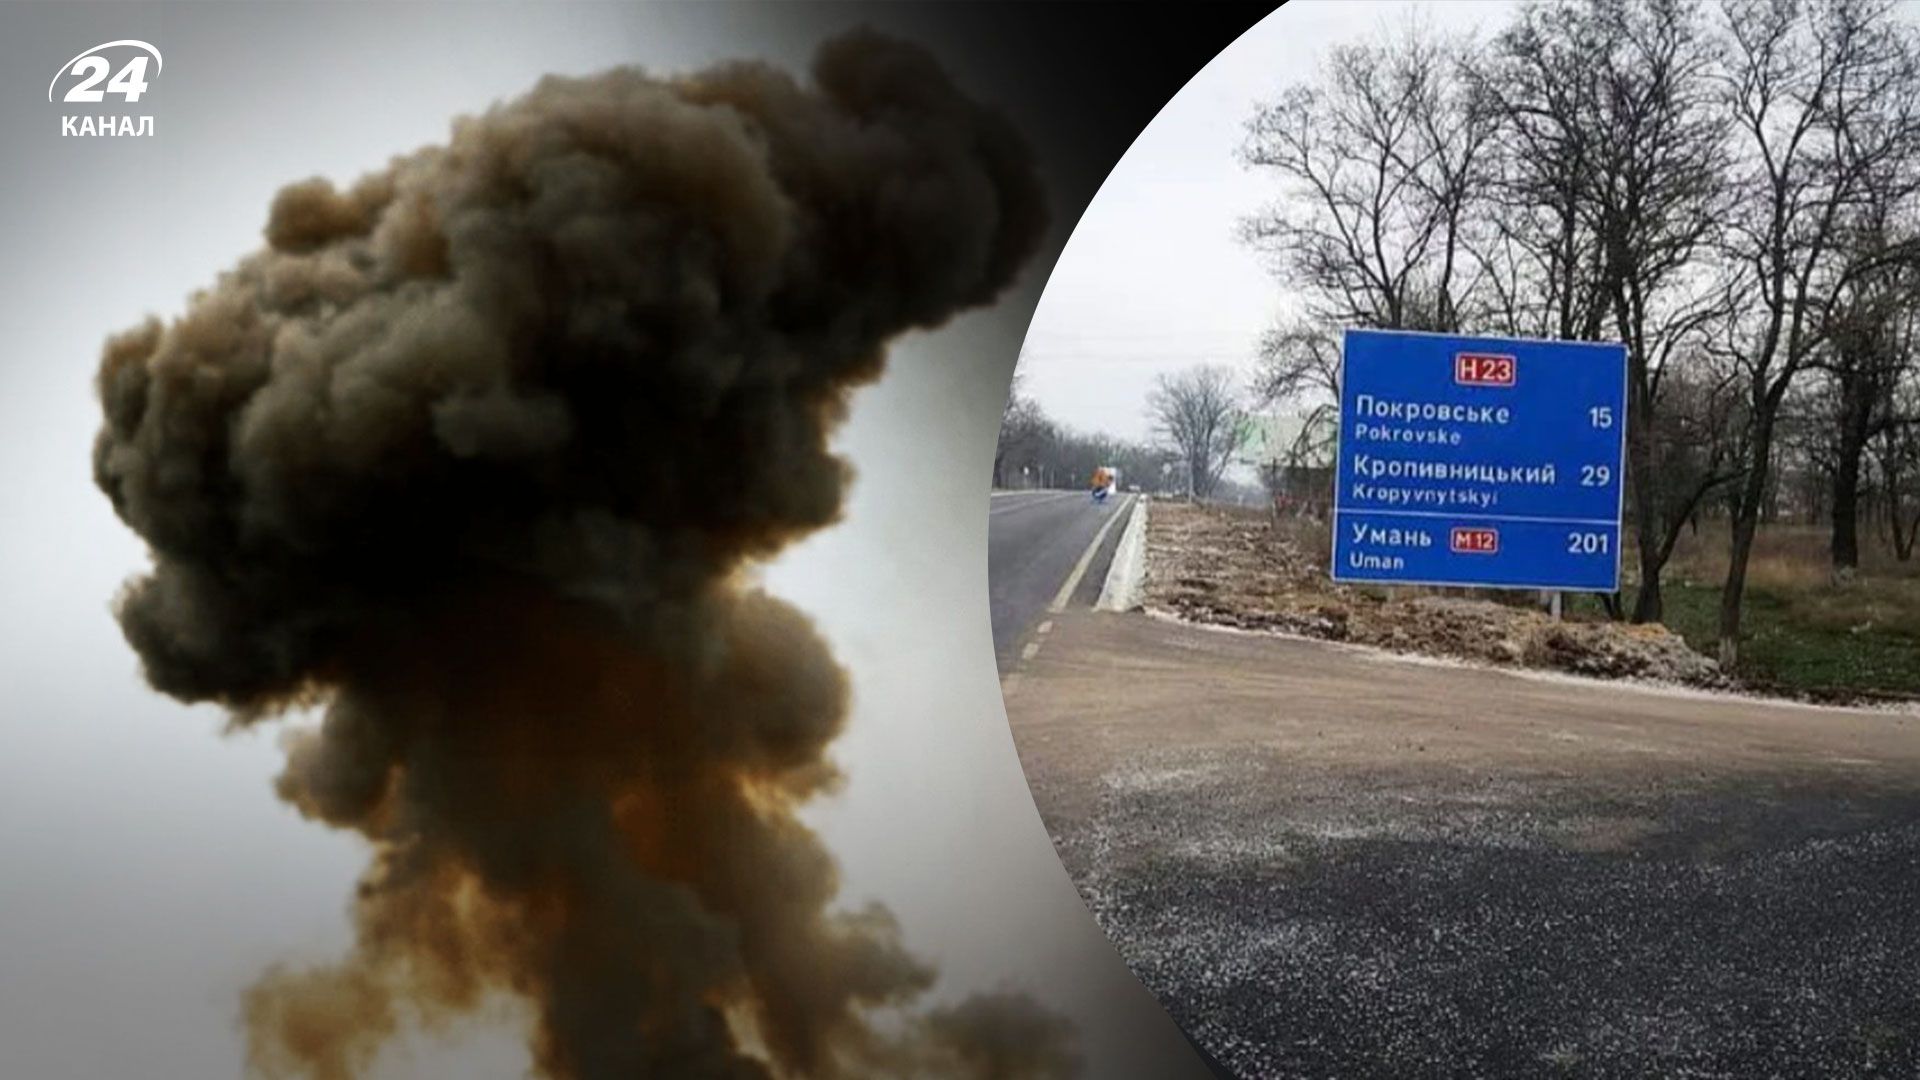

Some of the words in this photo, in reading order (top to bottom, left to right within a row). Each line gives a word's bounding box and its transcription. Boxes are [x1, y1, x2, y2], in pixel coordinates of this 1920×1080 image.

[1356, 395, 1510, 424] Покровське
[1590, 407, 1612, 428] 15
[1355, 424, 1461, 445] Pokrovske
[1353, 455, 1556, 485] Кропивницький
[1581, 466, 1610, 486] 29
[1352, 484, 1498, 508] Kropyvnytskyi
[1352, 524, 1432, 547] Умань
[1568, 533, 1609, 553] 201
[1350, 553, 1404, 570] Uman
